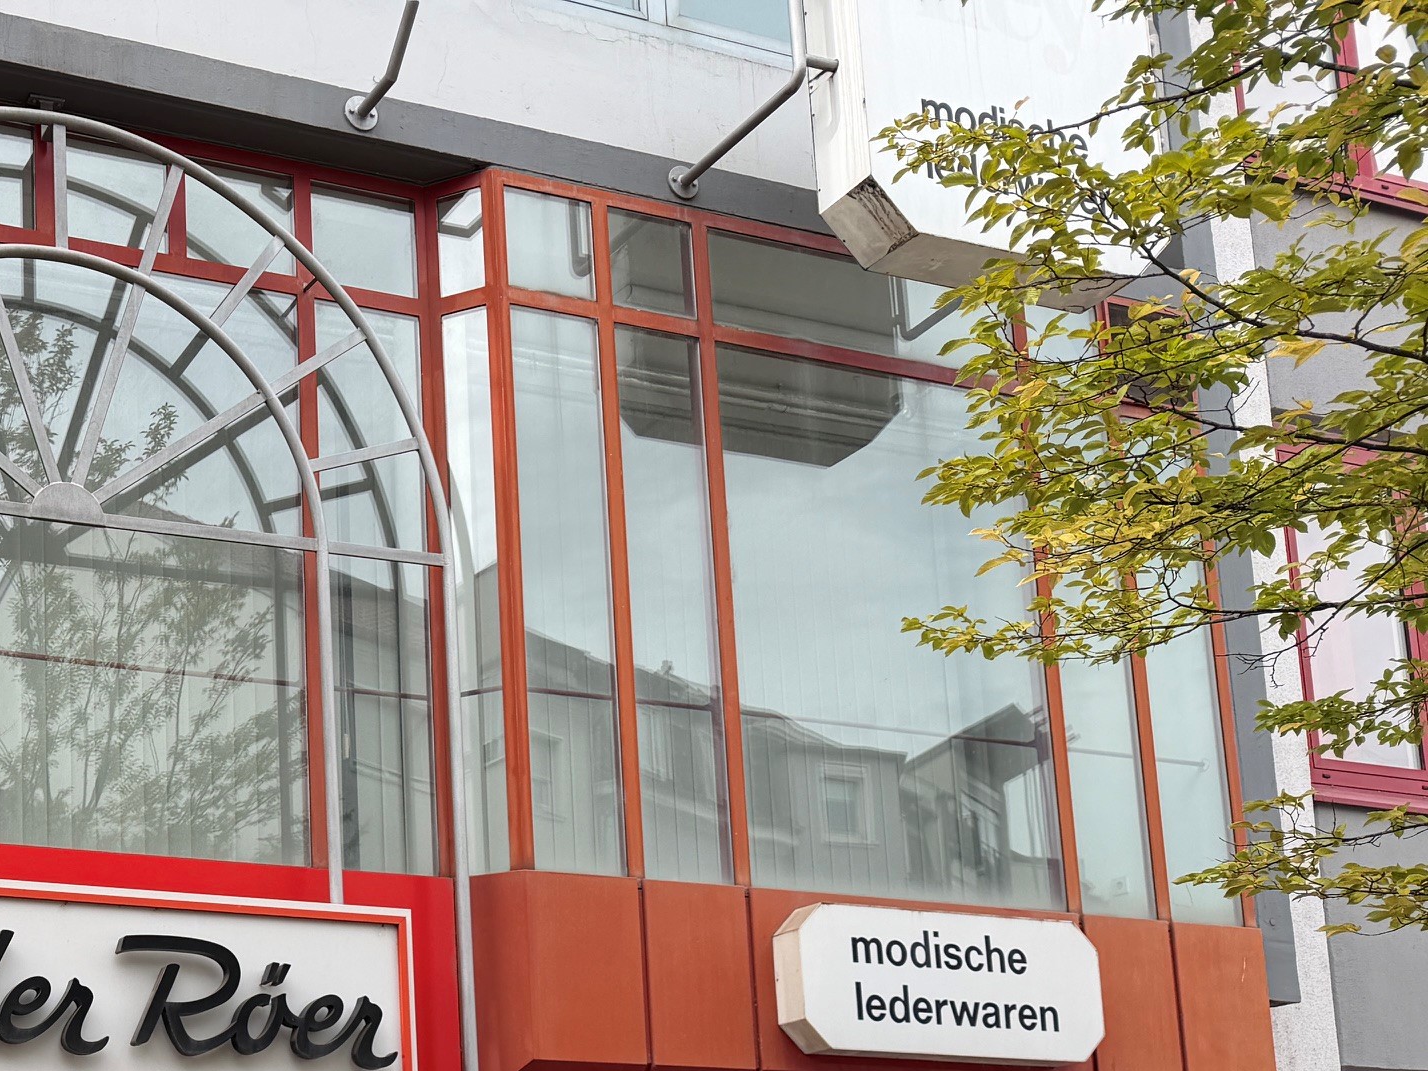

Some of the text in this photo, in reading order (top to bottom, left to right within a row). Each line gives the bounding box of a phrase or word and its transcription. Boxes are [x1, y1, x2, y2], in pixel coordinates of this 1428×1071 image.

[851, 931, 1028, 976] modische
[115, 934, 398, 1071] Röer
[856, 982, 1060, 1032] lederwaren
